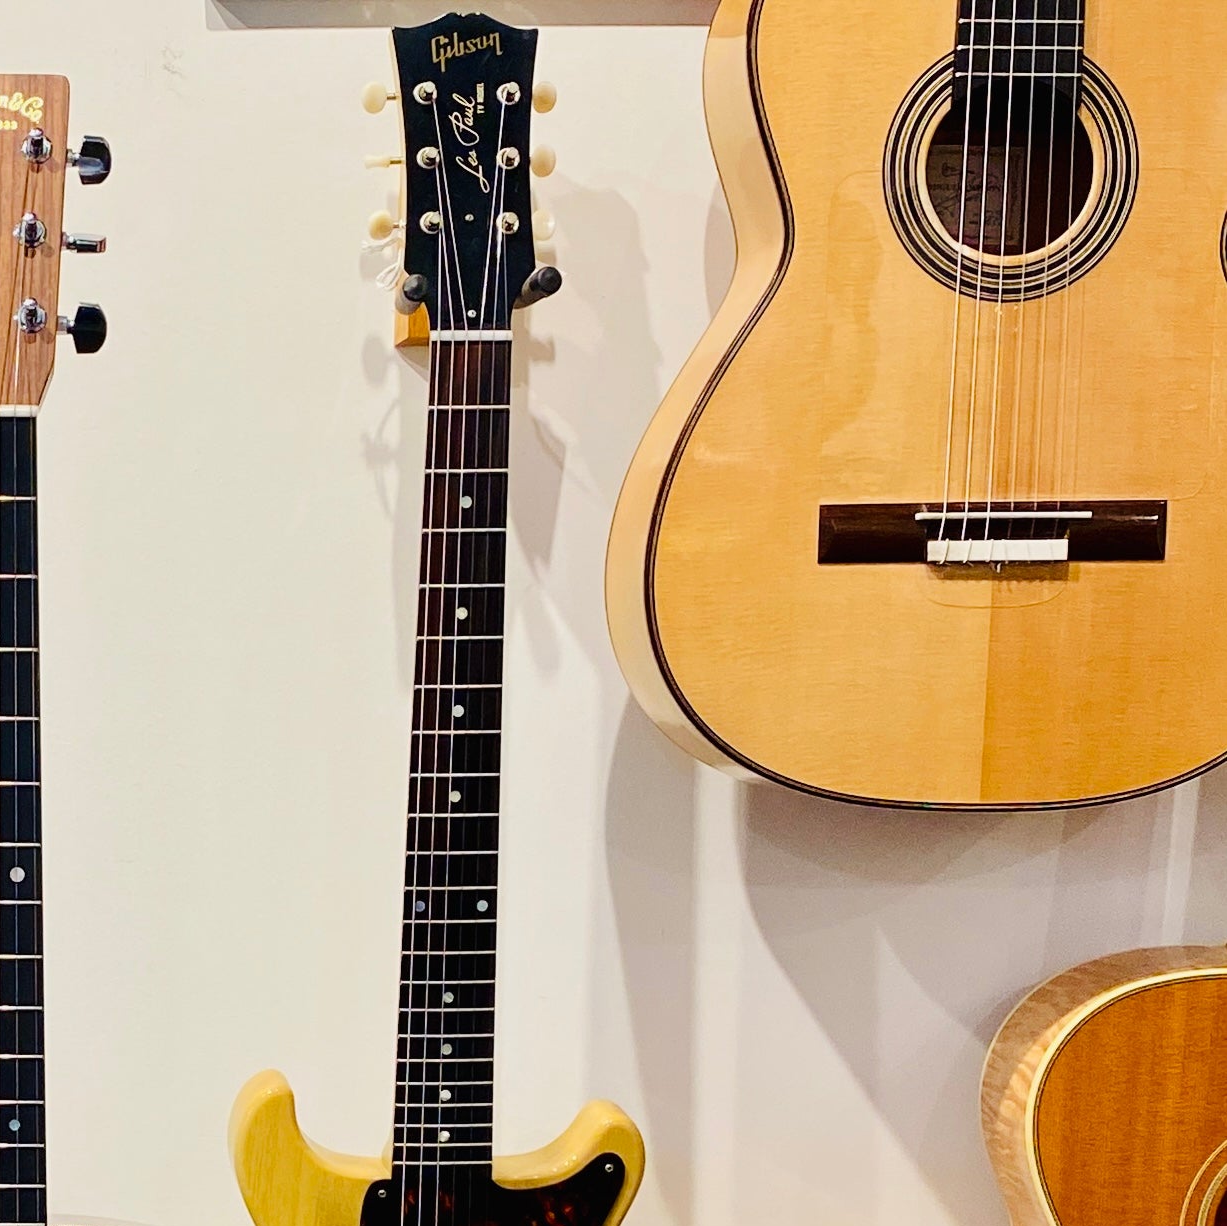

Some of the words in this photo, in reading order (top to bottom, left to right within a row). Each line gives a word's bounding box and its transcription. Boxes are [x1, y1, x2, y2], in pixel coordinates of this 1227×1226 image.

[430, 31, 503, 73] Gibson
[447, 92, 480, 147] Paul
[476, 104, 485, 115] TV
[455, 149, 491, 194] Les
